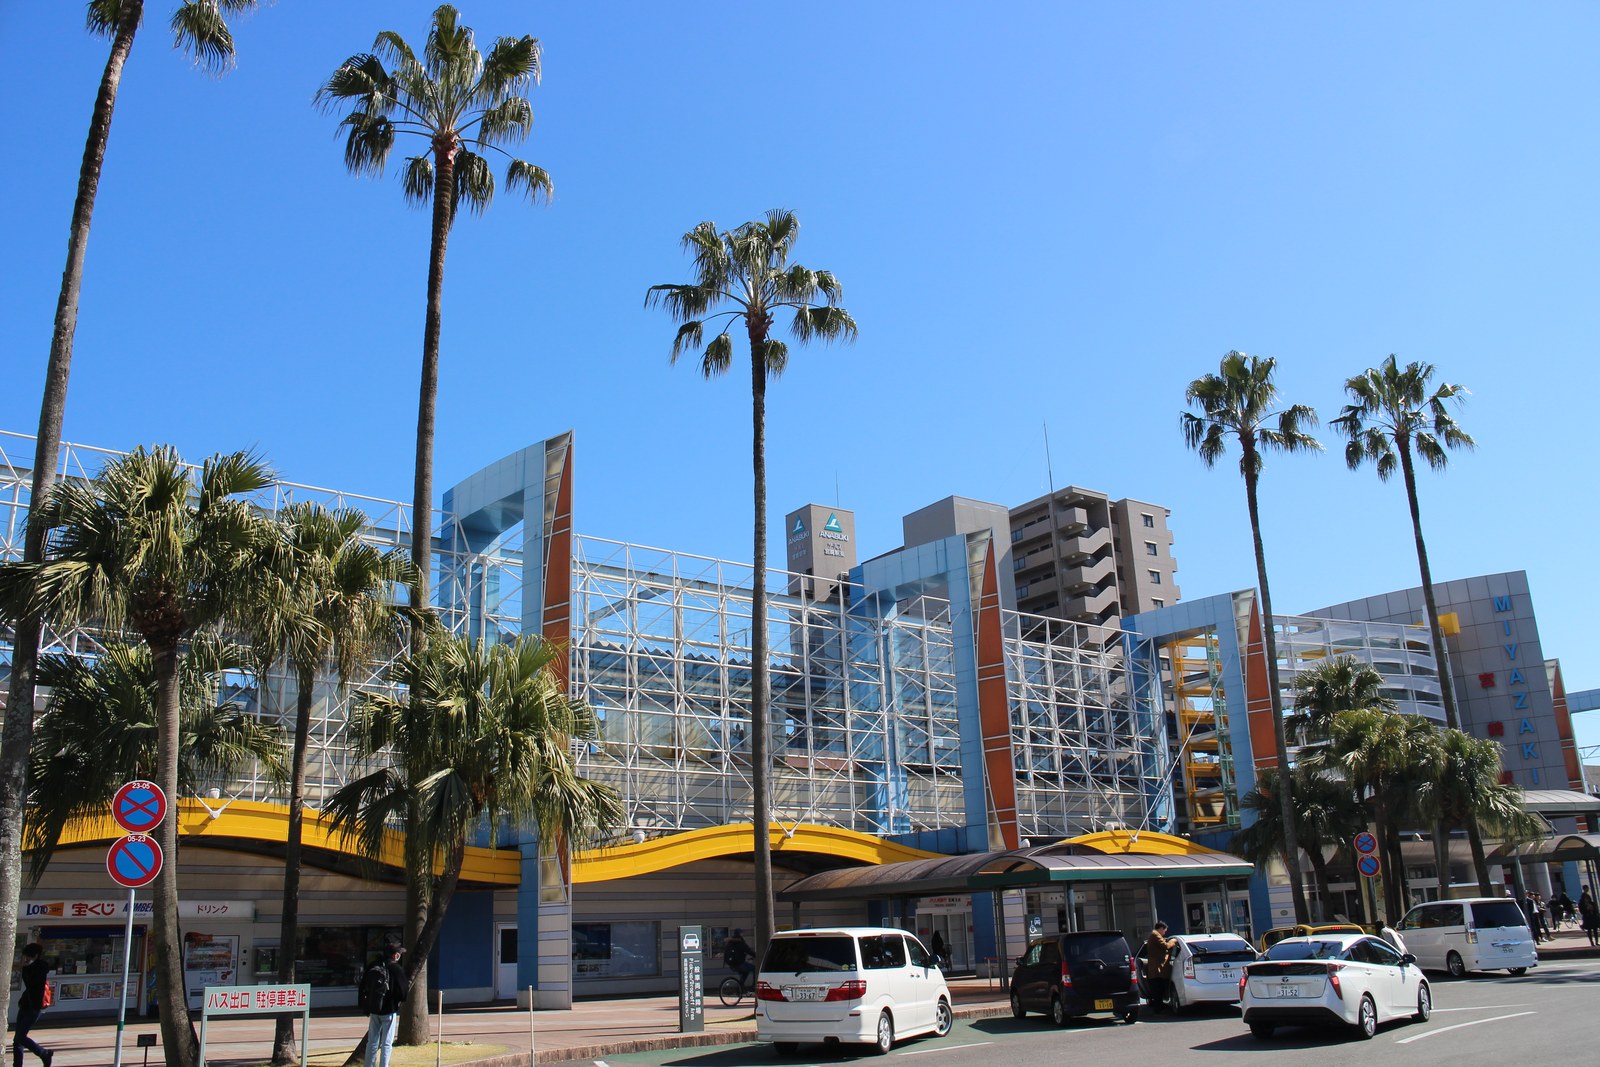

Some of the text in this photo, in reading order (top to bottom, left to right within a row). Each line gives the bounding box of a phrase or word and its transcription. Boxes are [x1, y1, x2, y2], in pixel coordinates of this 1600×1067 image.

[819, 531, 849, 542] ANABUKI
[1493, 595, 1539, 785] MIYAZAKI
[71, 902, 115, 917] 宝くじ
[196, 904, 229, 914] ドリンク
[256, 989, 307, 1009] 駐停車禁止
